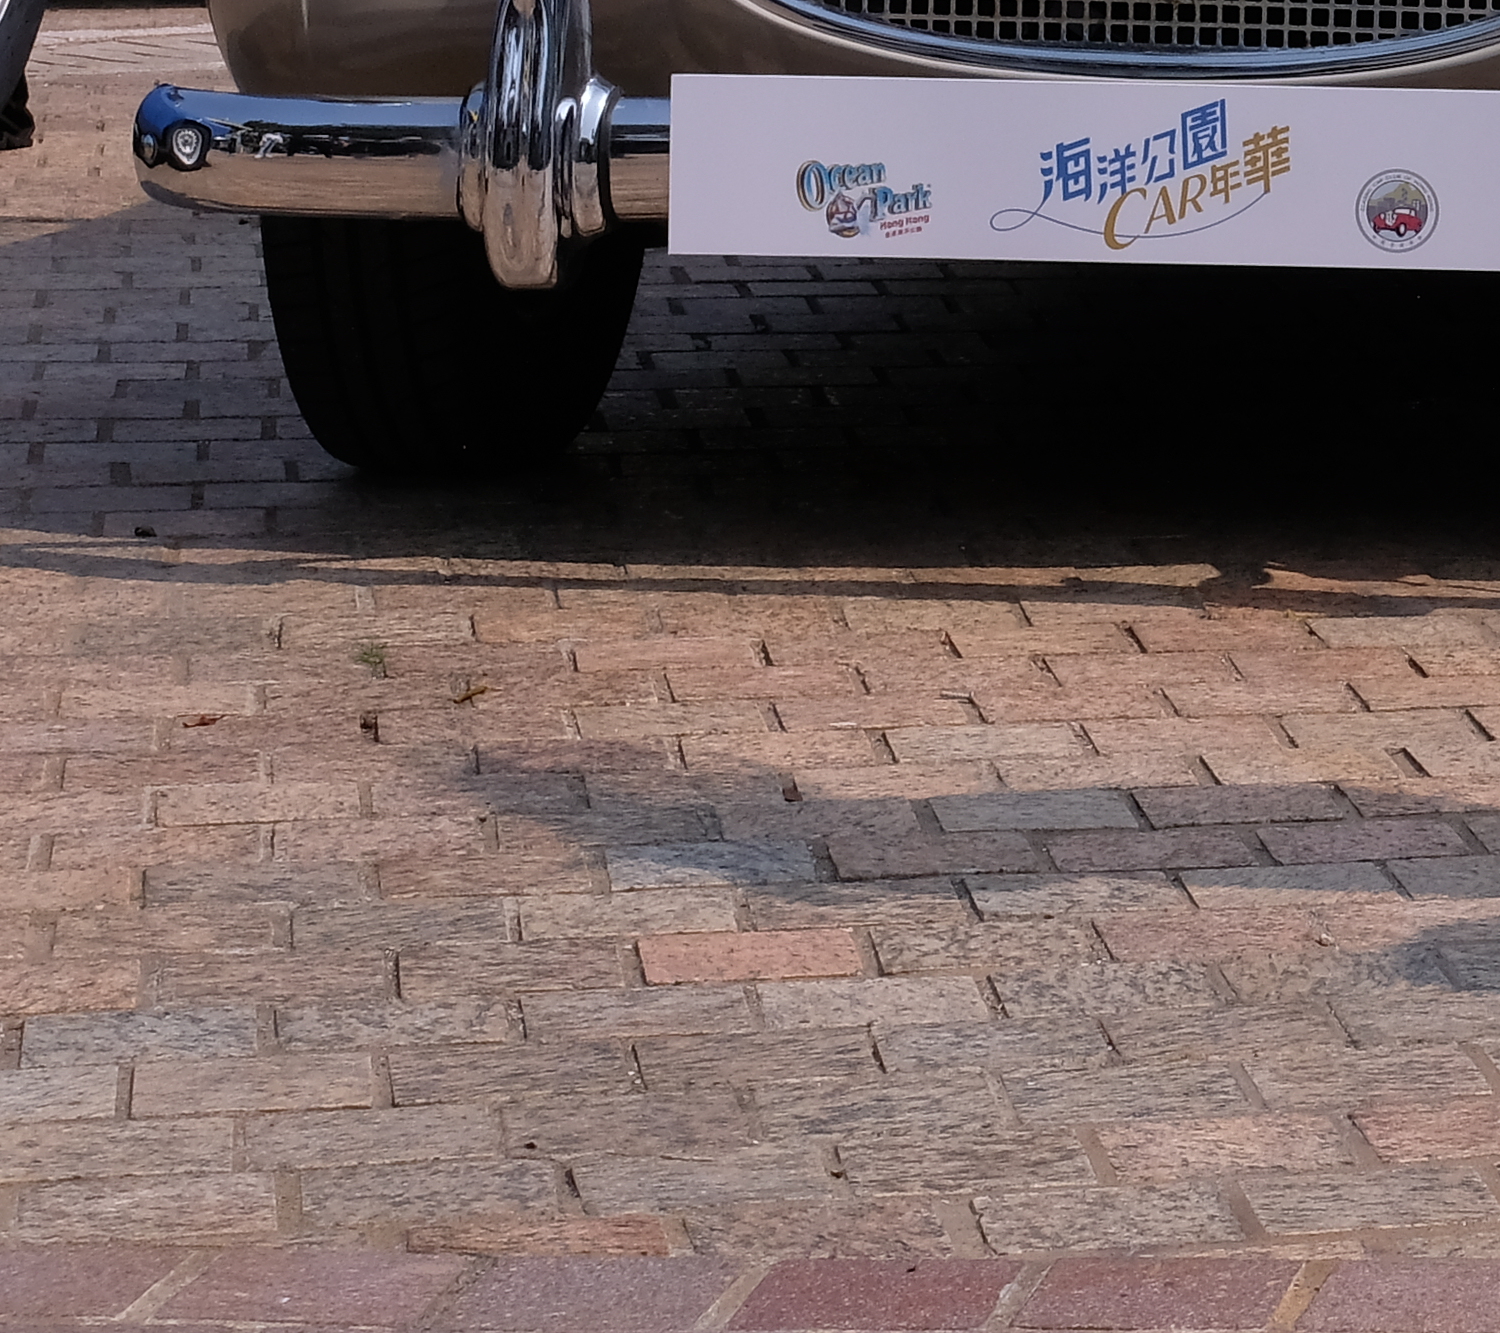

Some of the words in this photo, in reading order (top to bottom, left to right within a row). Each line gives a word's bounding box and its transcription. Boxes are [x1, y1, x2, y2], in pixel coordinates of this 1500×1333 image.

[1039, 98, 1228, 206] 海洋公園
[796, 159, 887, 212] Ocean
[869, 182, 933, 223] Park
[879, 217, 904, 231] Hong
[905, 214, 930, 227] Kong
